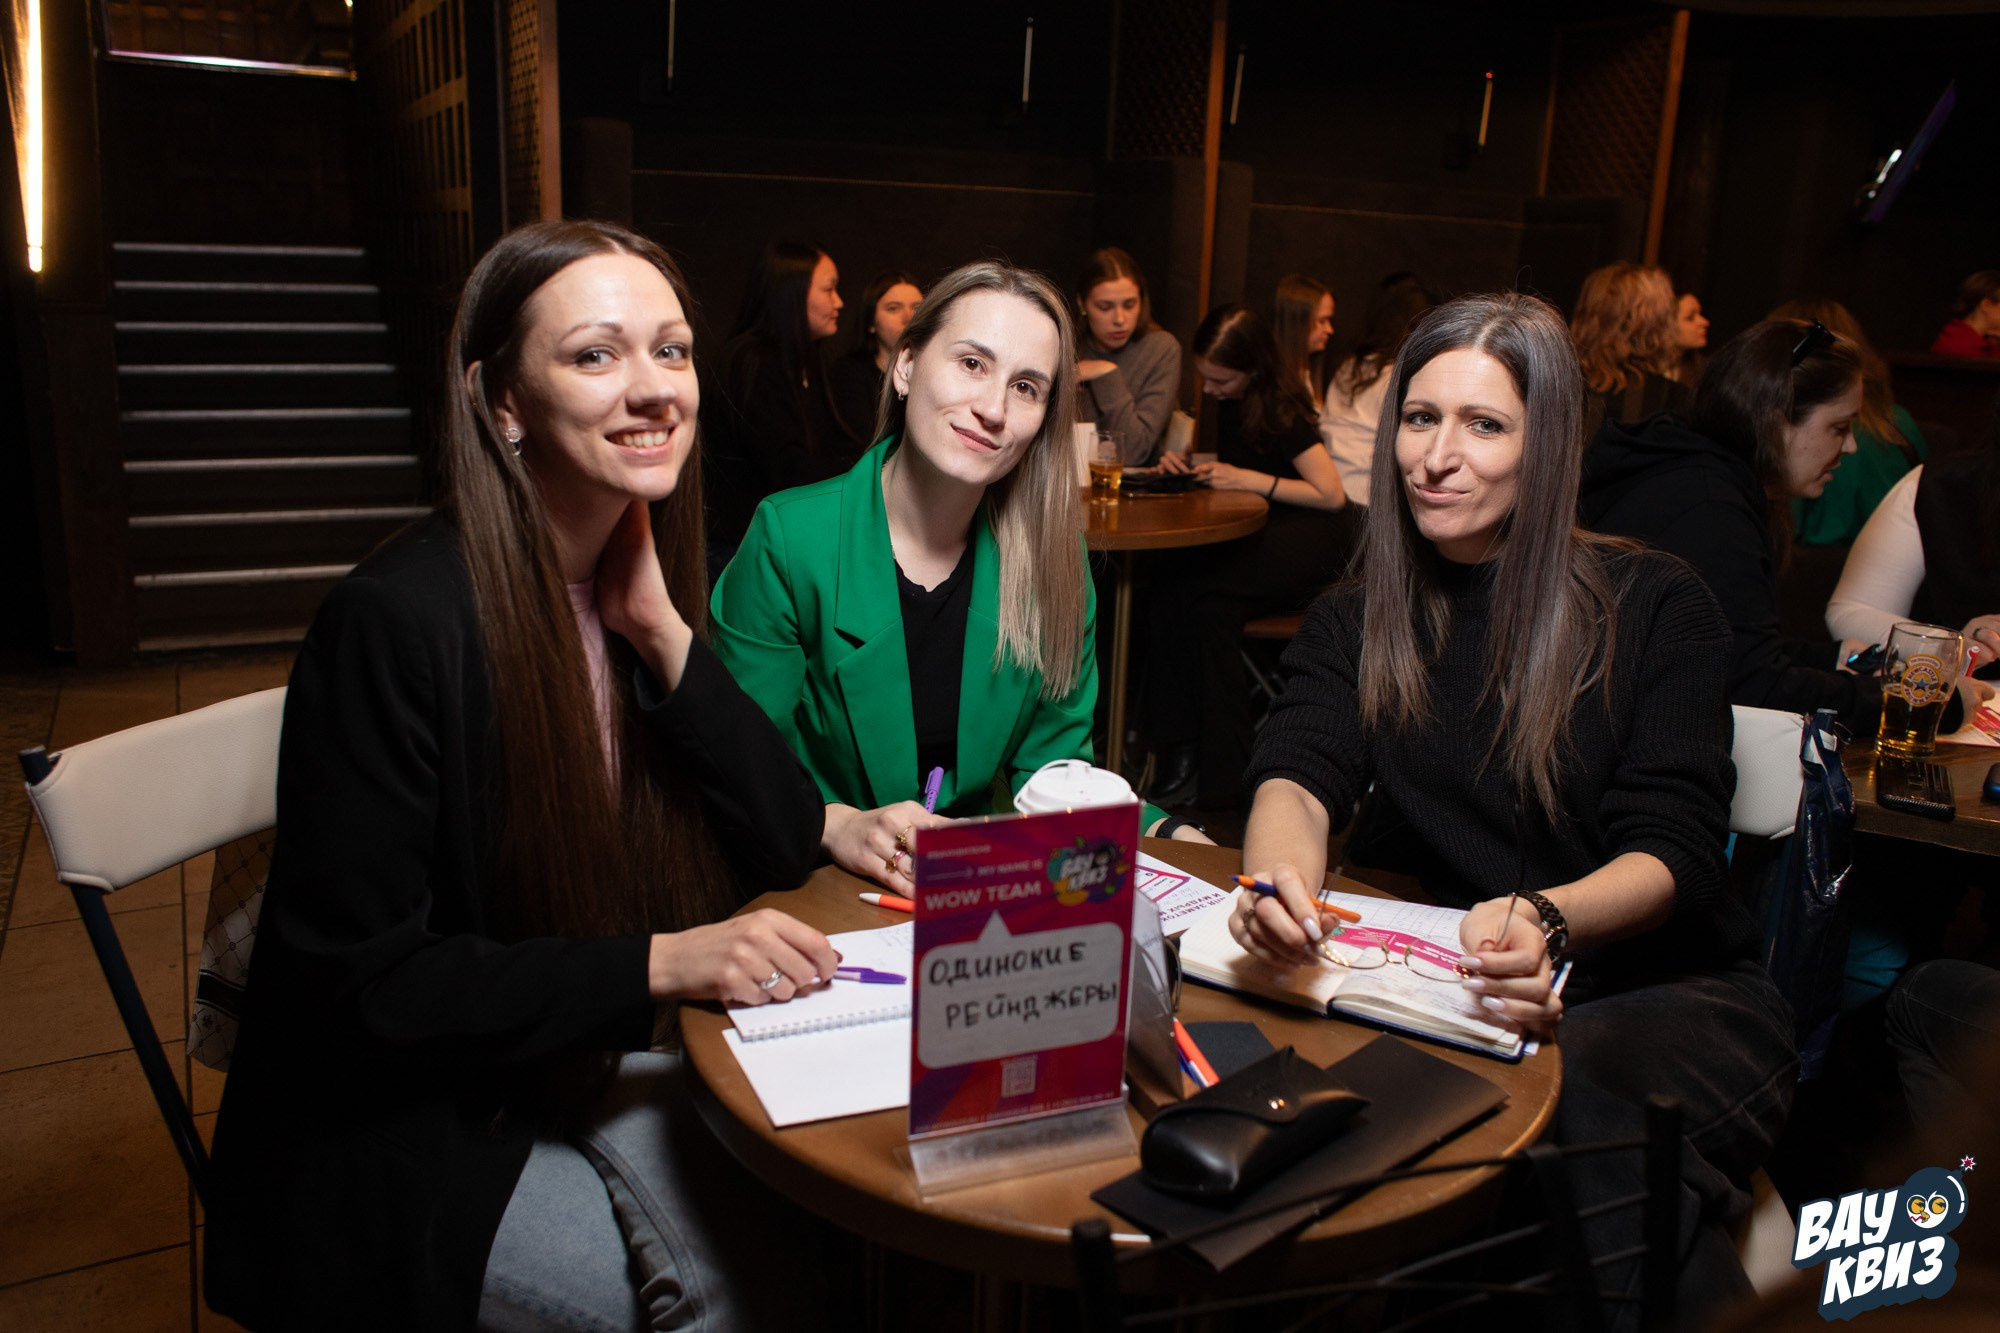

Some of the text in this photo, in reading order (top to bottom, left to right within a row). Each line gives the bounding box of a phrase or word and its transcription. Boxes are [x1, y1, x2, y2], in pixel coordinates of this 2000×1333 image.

[1907, 666, 1938, 682] NEWCASTLE
[925, 880, 1041, 911] WOW TEAM
[929, 942, 1087, 987] ОДИНОКИЕ
[945, 982, 1117, 1029] РЕЙНДЖЕРЫ
